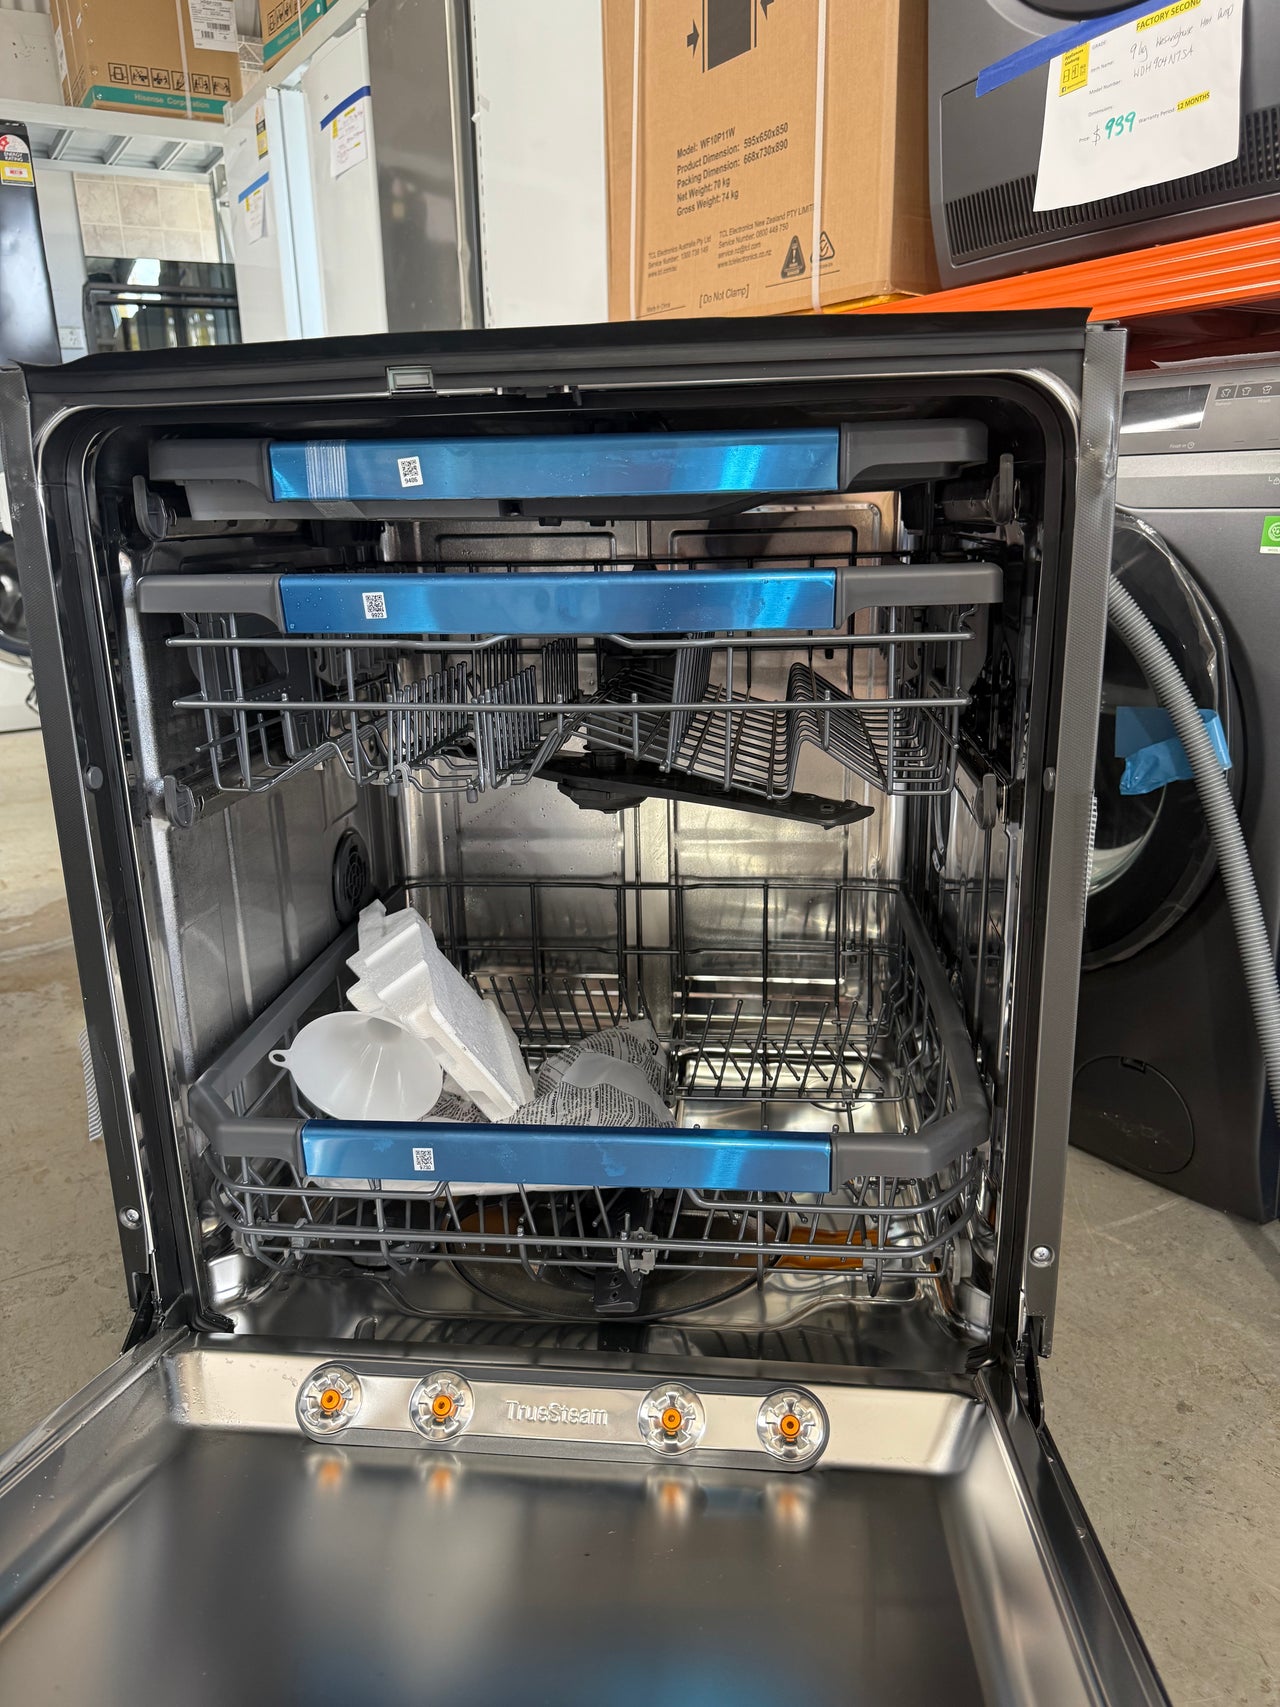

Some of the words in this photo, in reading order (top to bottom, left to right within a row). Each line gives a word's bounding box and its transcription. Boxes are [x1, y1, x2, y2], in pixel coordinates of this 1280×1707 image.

[1136, 10, 1169, 31] FACTORY
[134, 93, 164, 104] Hisense
[1092, 124, 1101, 146] $
[1177, 102, 1184, 110] 12
[1185, 91, 1210, 106] MONTHS
[676, 144, 698, 159] Model:
[700, 126, 736, 150] WF10P11W
[677, 159, 702, 175] Product
[703, 144, 740, 165] Dimension:
[743, 122, 789, 149] 595x650x850
[677, 172, 702, 189] Packing
[703, 159, 740, 180] Dimension:
[743, 138, 789, 165] 668x730x890
[677, 192, 688, 203] Net
[689, 183, 712, 199] Weight:
[722, 177, 731, 188] kg
[677, 204, 695, 217] Gross
[697, 195, 720, 209] Weight:
[722, 191, 730, 202] 74
[731, 189, 739, 201] kg
[719, 230, 728, 239] TCL
[729, 223, 754, 236] Electronics
[755, 219, 765, 228] New
[766, 212, 786, 223] Zealand
[786, 209, 797, 220] PTY
[718, 238, 735, 249] Service
[713, 291, 724, 301] Not
[505, 1399, 608, 1426] TrueSteam
